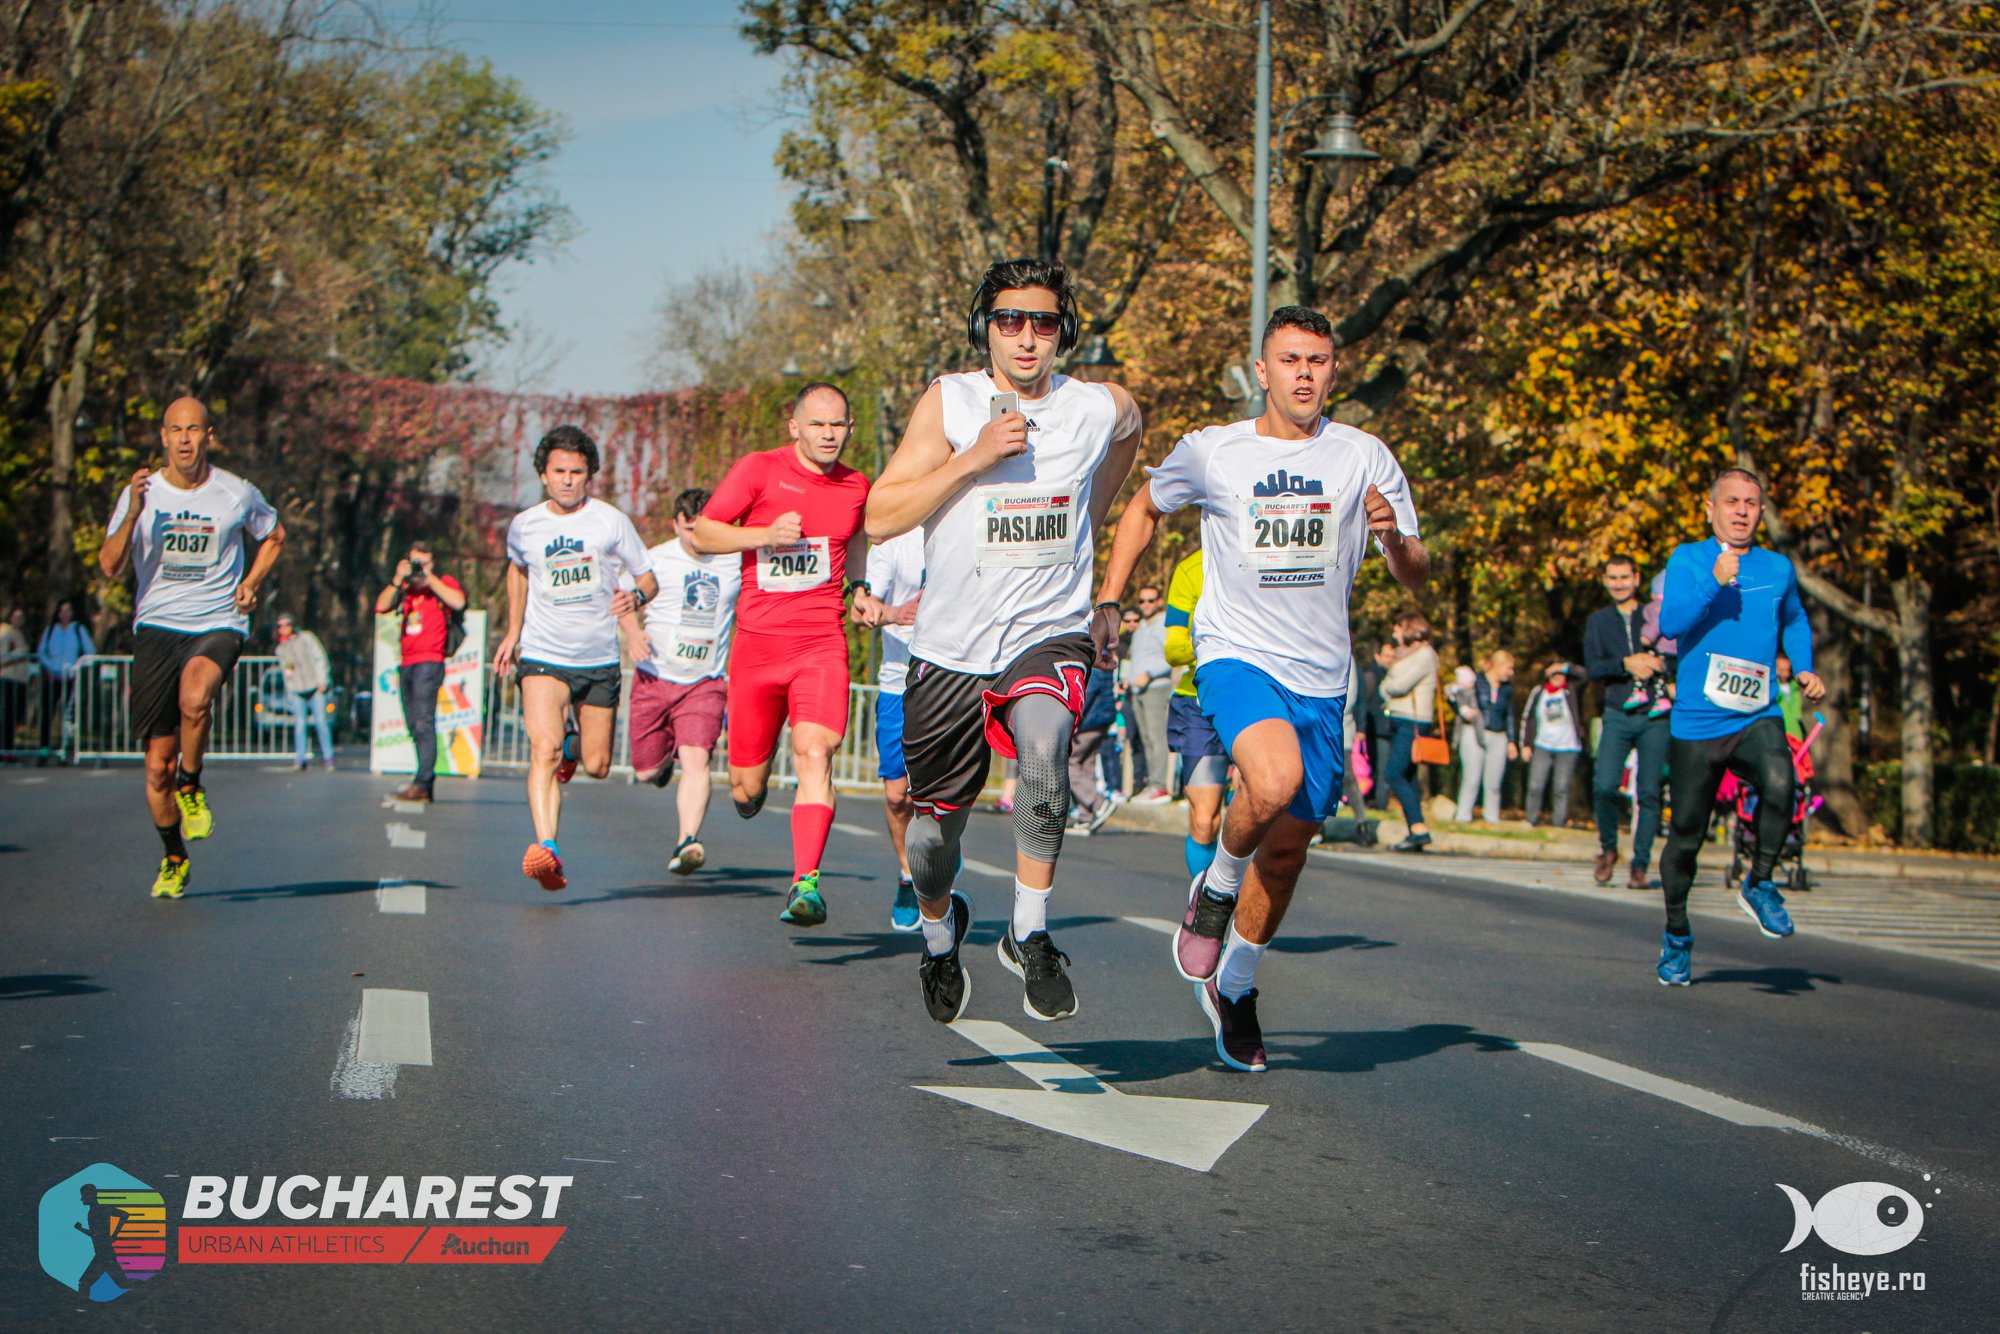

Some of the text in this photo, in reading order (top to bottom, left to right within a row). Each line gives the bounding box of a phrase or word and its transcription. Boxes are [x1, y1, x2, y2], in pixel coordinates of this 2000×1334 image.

[1004, 496, 1051, 504] BUCHAREST
[987, 513, 1068, 543] PASLARU
[1254, 518, 1324, 548] 2048
[165, 533, 209, 552] 2037
[551, 565, 591, 587] 2044
[769, 554, 818, 577] 2042
[1260, 572, 1325, 582] SKECHERS
[676, 643, 709, 660] 2047
[1717, 671, 1761, 699] 2022
